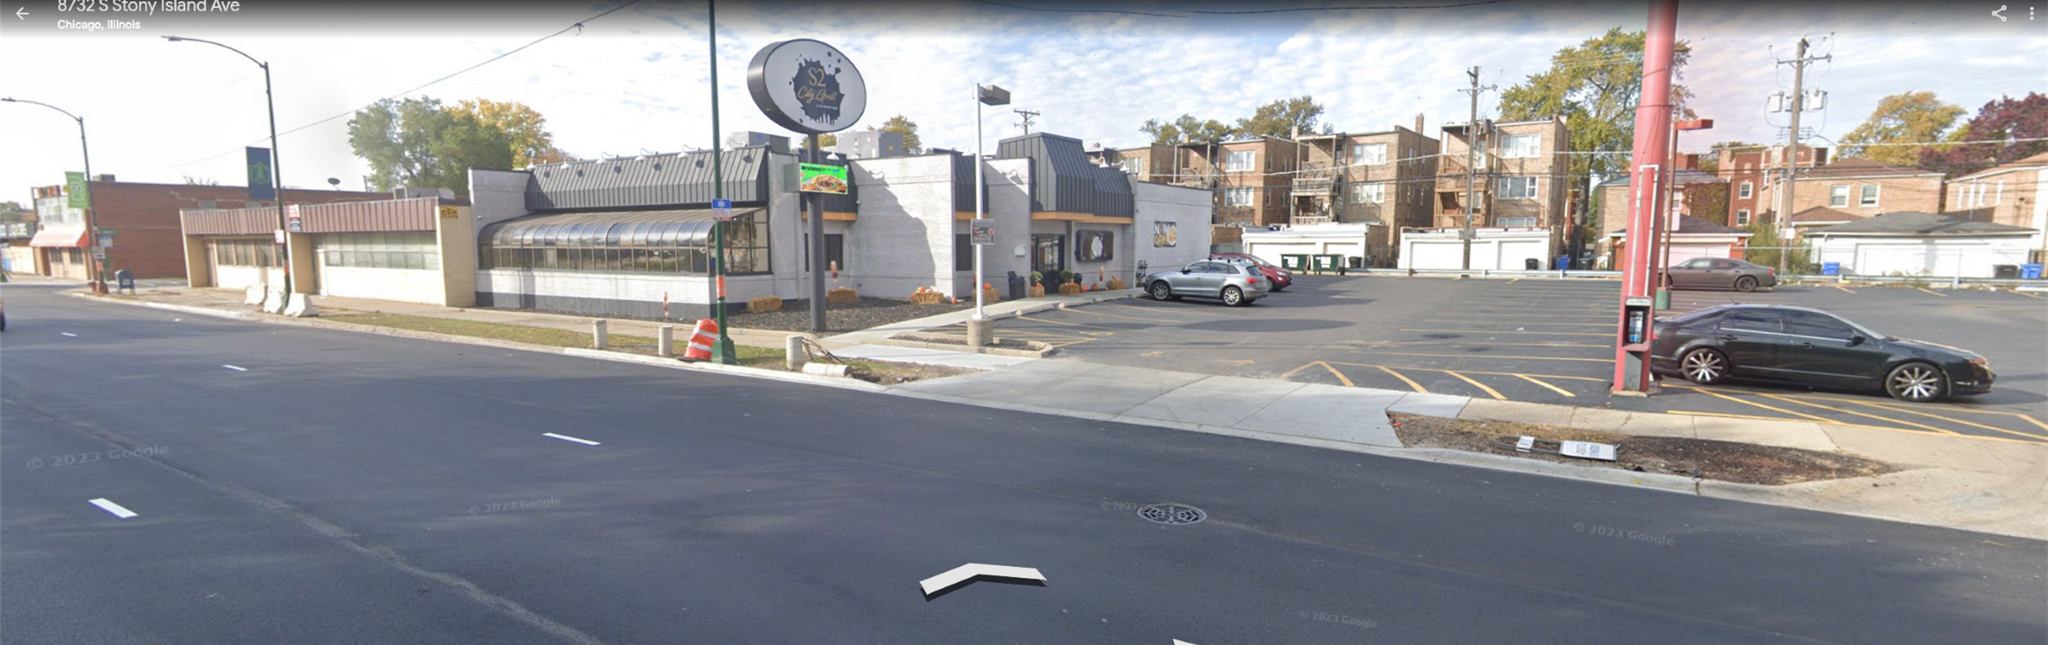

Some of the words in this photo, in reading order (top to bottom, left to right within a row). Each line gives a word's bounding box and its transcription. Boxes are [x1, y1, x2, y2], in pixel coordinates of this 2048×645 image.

[808, 67, 826, 87] S2
[798, 86, 815, 104] City
[816, 88, 838, 103] Grill
